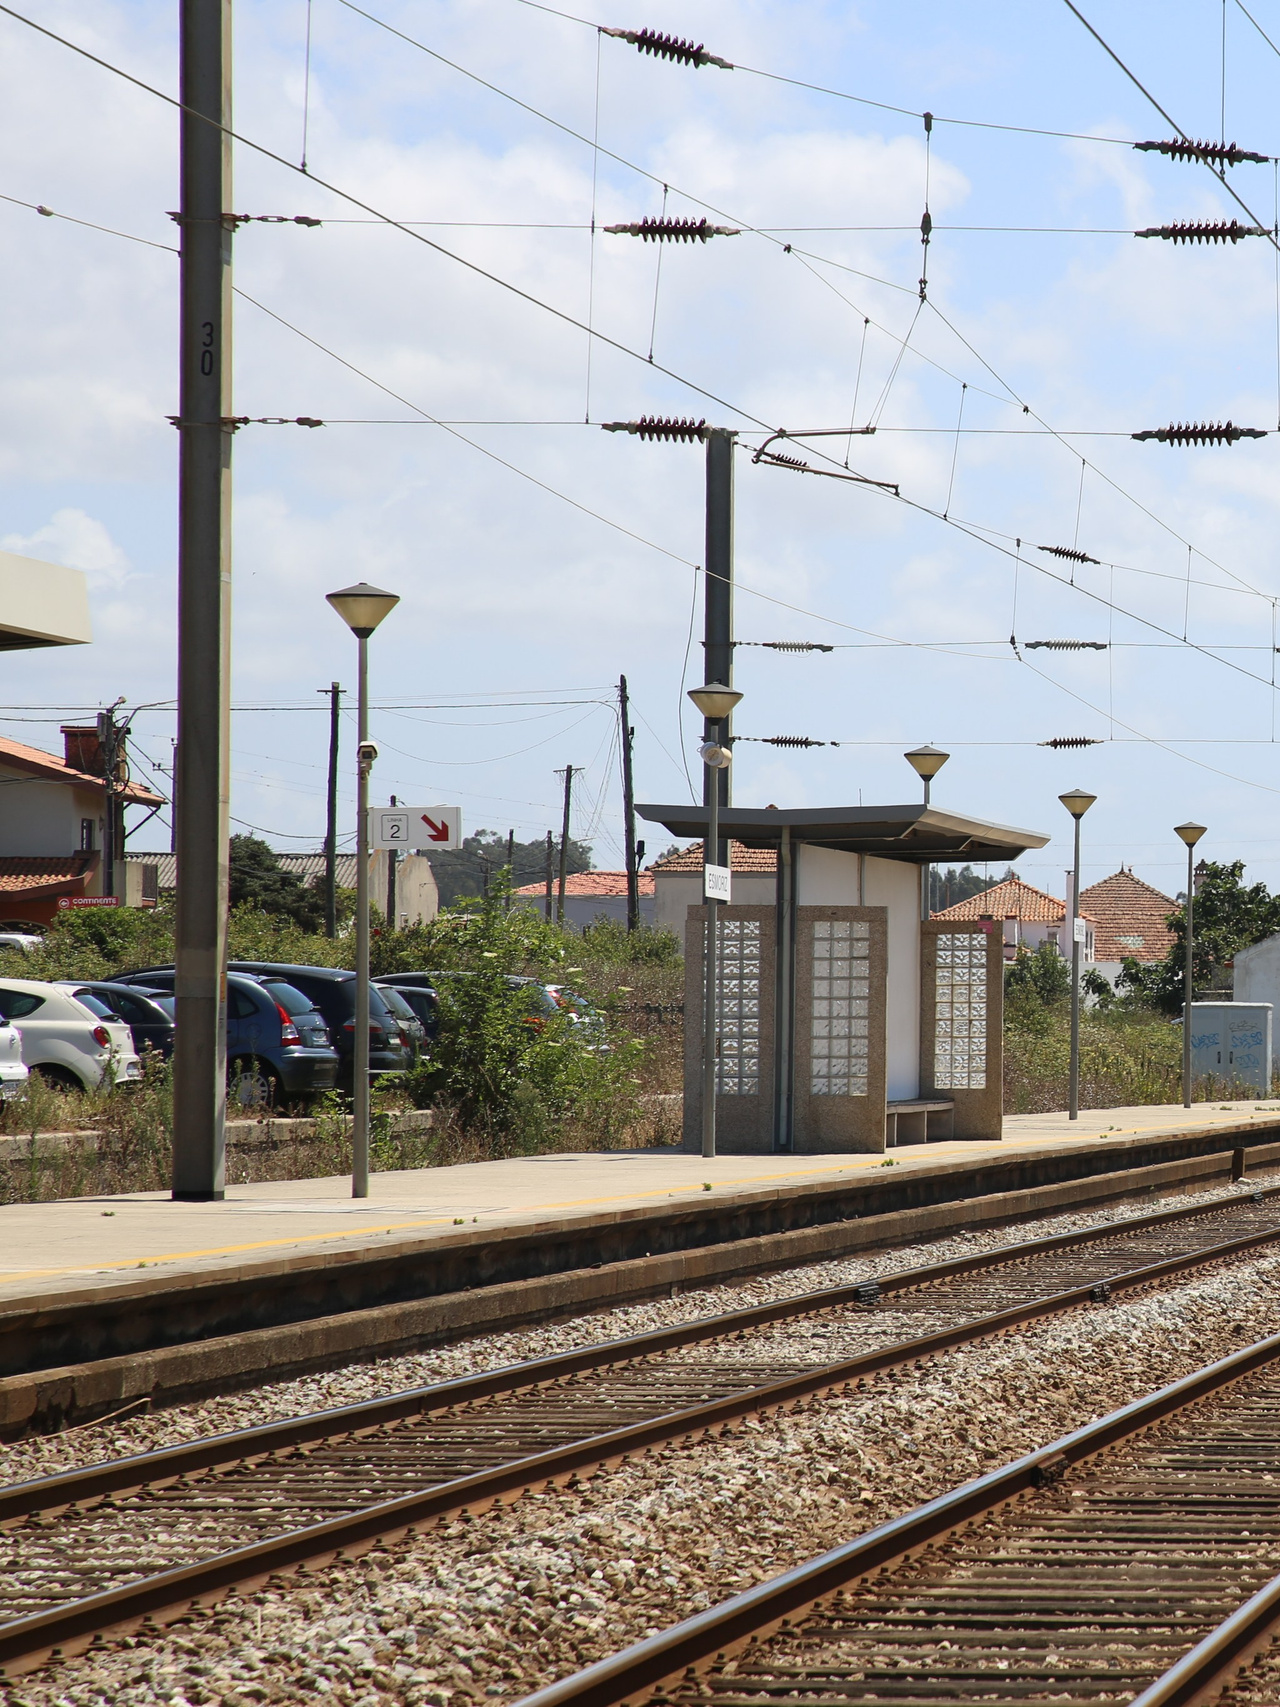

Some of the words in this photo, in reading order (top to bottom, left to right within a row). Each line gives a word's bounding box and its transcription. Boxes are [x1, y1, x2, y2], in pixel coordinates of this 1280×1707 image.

[202, 322, 213, 376] 30
[390, 825, 401, 838] 2
[709, 872, 728, 892] ESMORIZ
[72, 897, 117, 905] CONTINENTE
